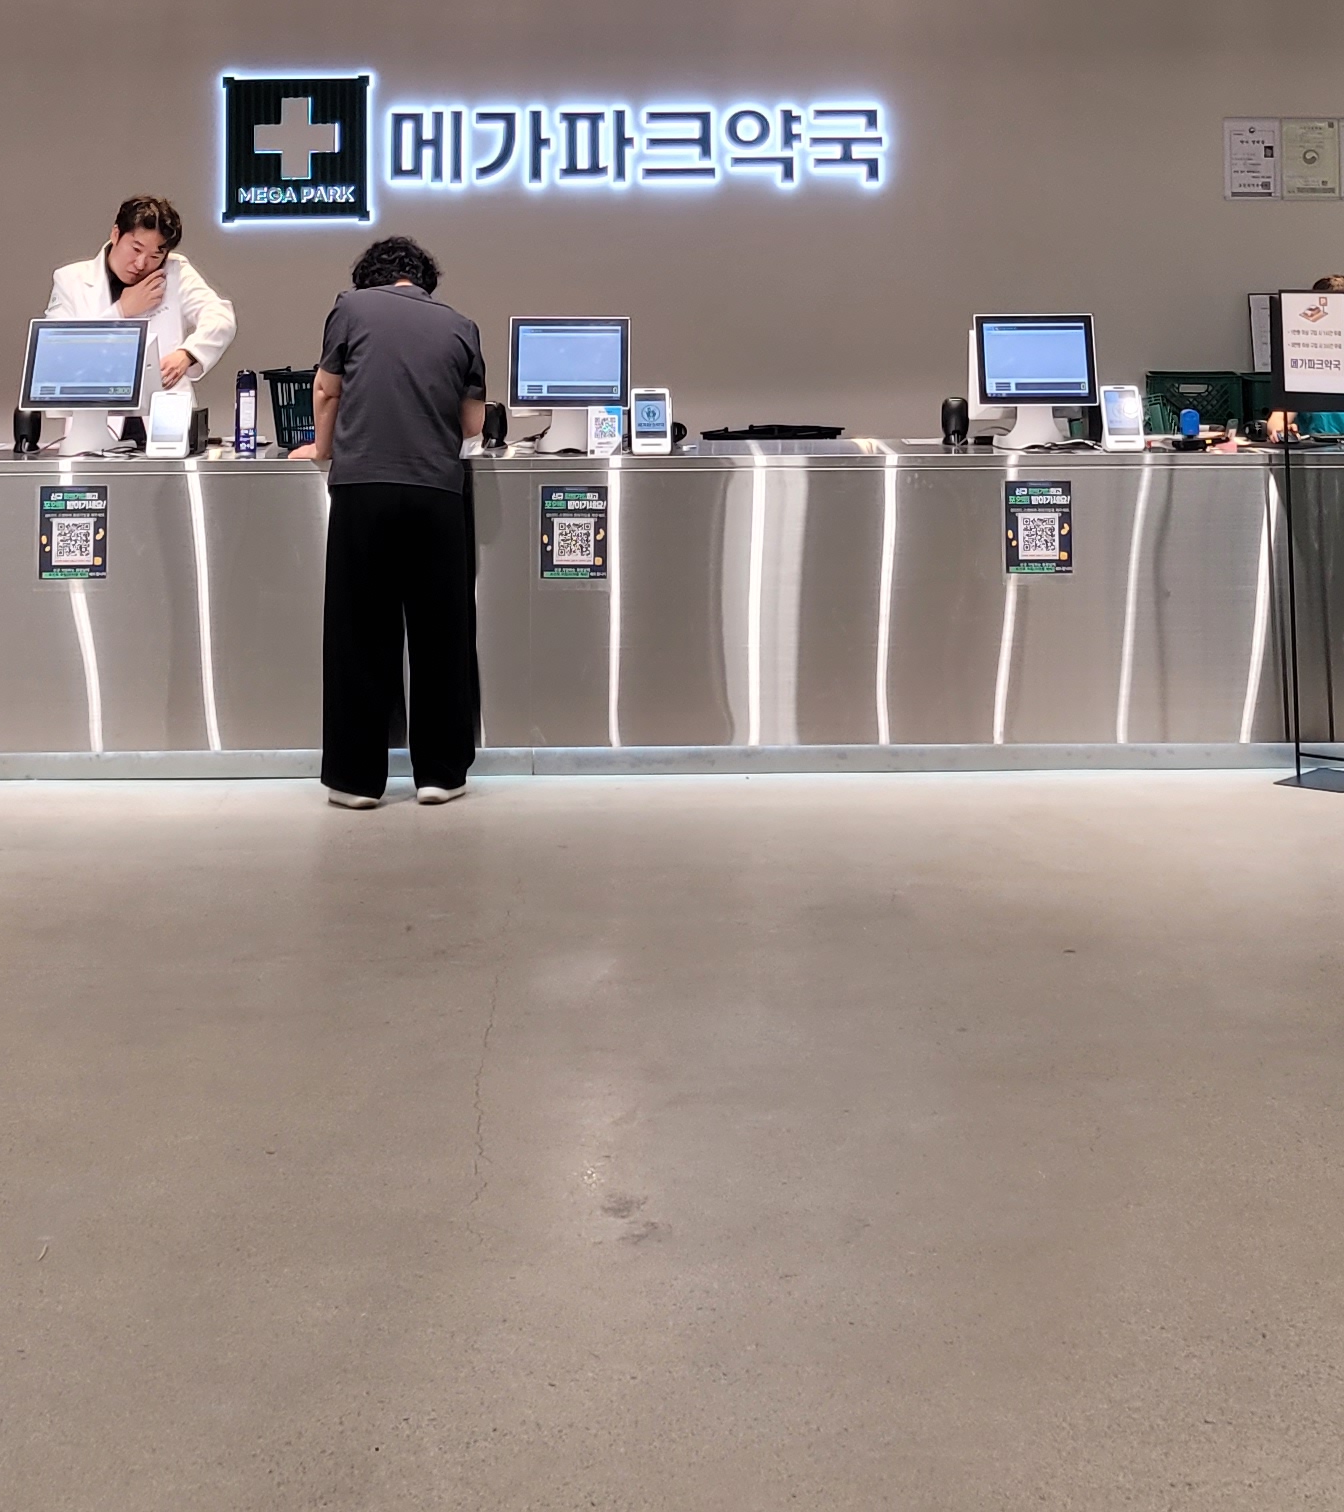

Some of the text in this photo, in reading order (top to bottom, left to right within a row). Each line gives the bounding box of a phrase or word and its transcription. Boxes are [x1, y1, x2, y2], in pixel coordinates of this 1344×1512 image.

[389, 107, 885, 185] 메가파크약국
[238, 186, 356, 204] MEGA PARK
[1291, 358, 1342, 371] 메가파크약국
